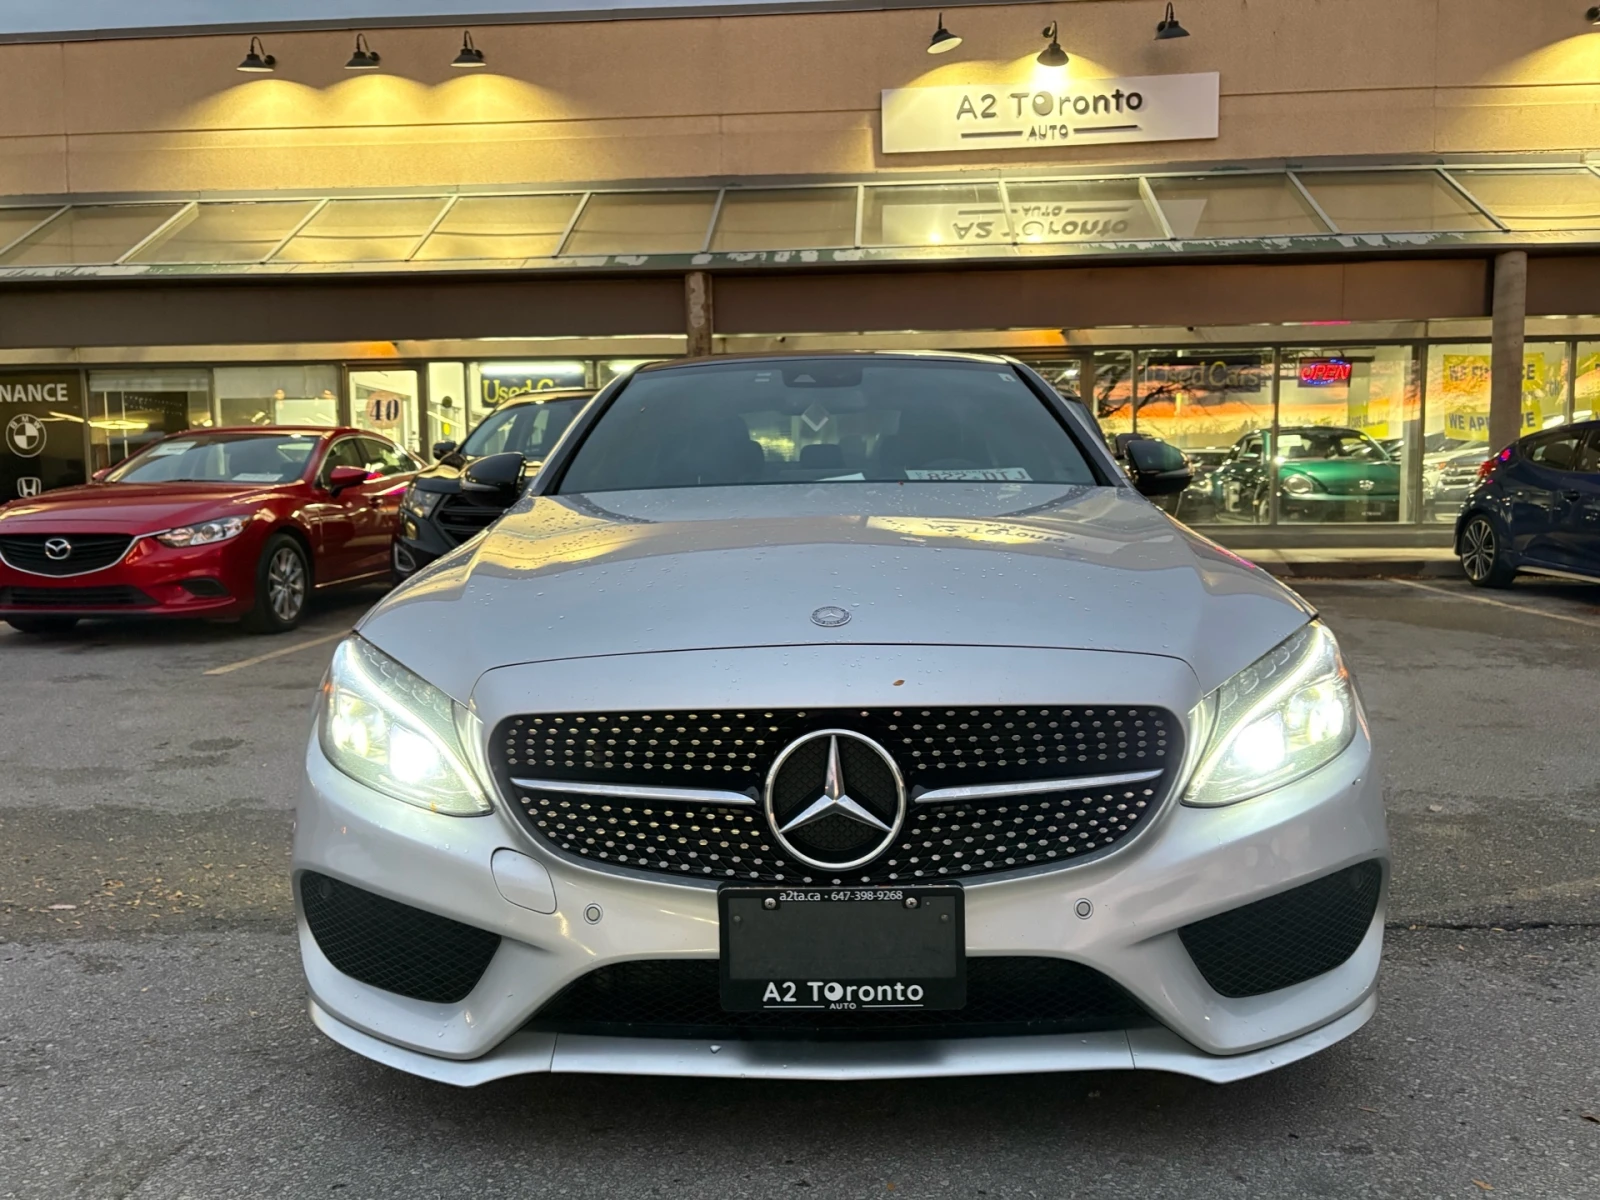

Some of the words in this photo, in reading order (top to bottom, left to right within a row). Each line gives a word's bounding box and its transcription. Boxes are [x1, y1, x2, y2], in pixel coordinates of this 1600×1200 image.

[956, 93, 998, 121] A2
[1027, 124, 1069, 140] AUTO
[1208, 361, 1260, 386] Cars
[1300, 363, 1351, 381] OPEN
[369, 399, 400, 421] 40
[1448, 412, 1465, 430] WE
[779, 891, 821, 902] a2ta.ca
[831, 890, 904, 902] 647-398-9268
[762, 981, 797, 1003] A2
[829, 1002, 857, 1010] AUTO
